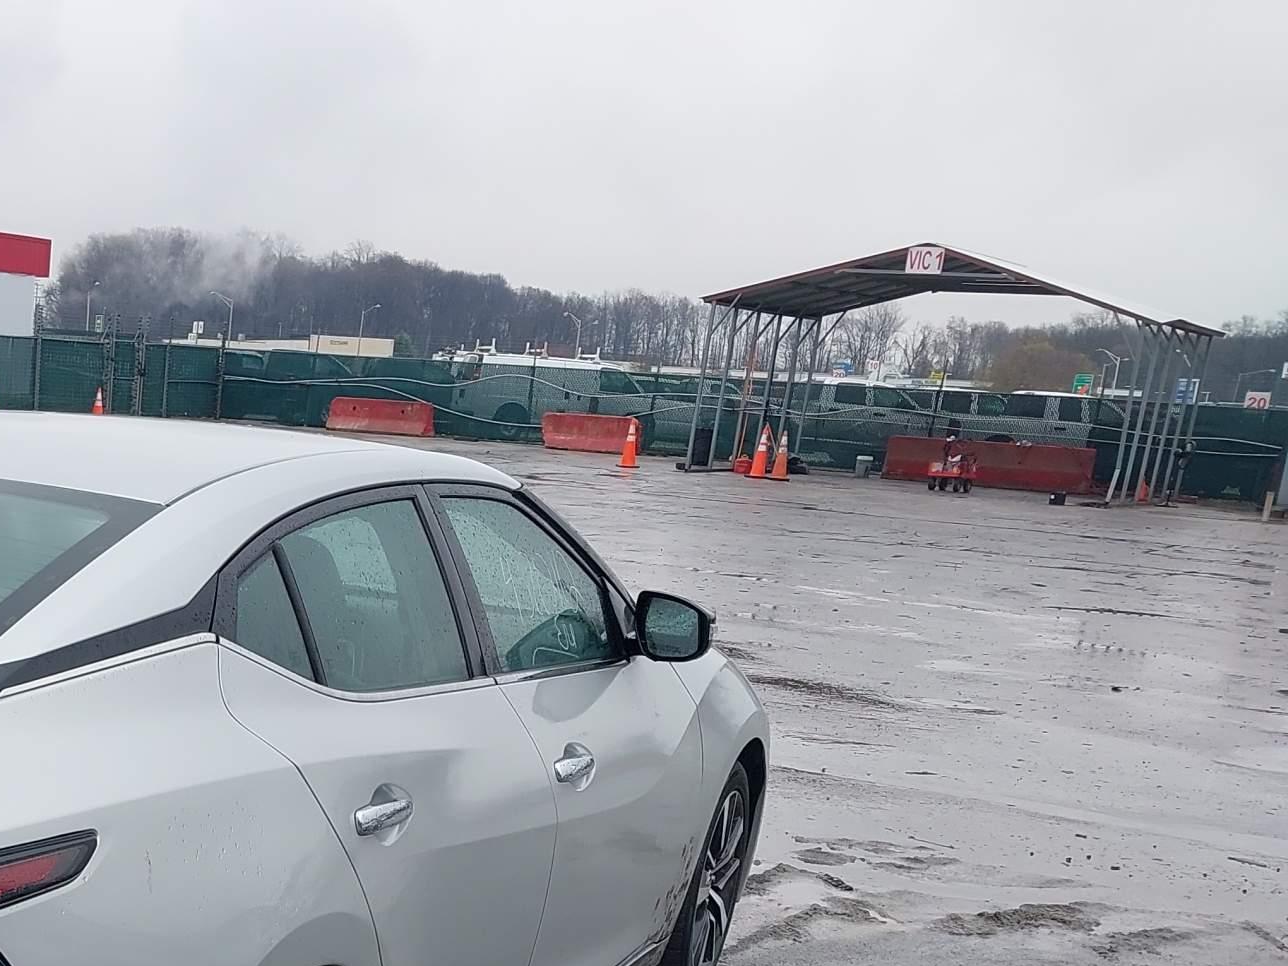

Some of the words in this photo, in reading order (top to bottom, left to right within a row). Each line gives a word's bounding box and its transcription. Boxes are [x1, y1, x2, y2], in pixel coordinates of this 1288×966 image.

[909, 250, 932, 270] VIC
[936, 251, 944, 270] 1
[1247, 397, 1267, 410] 20
